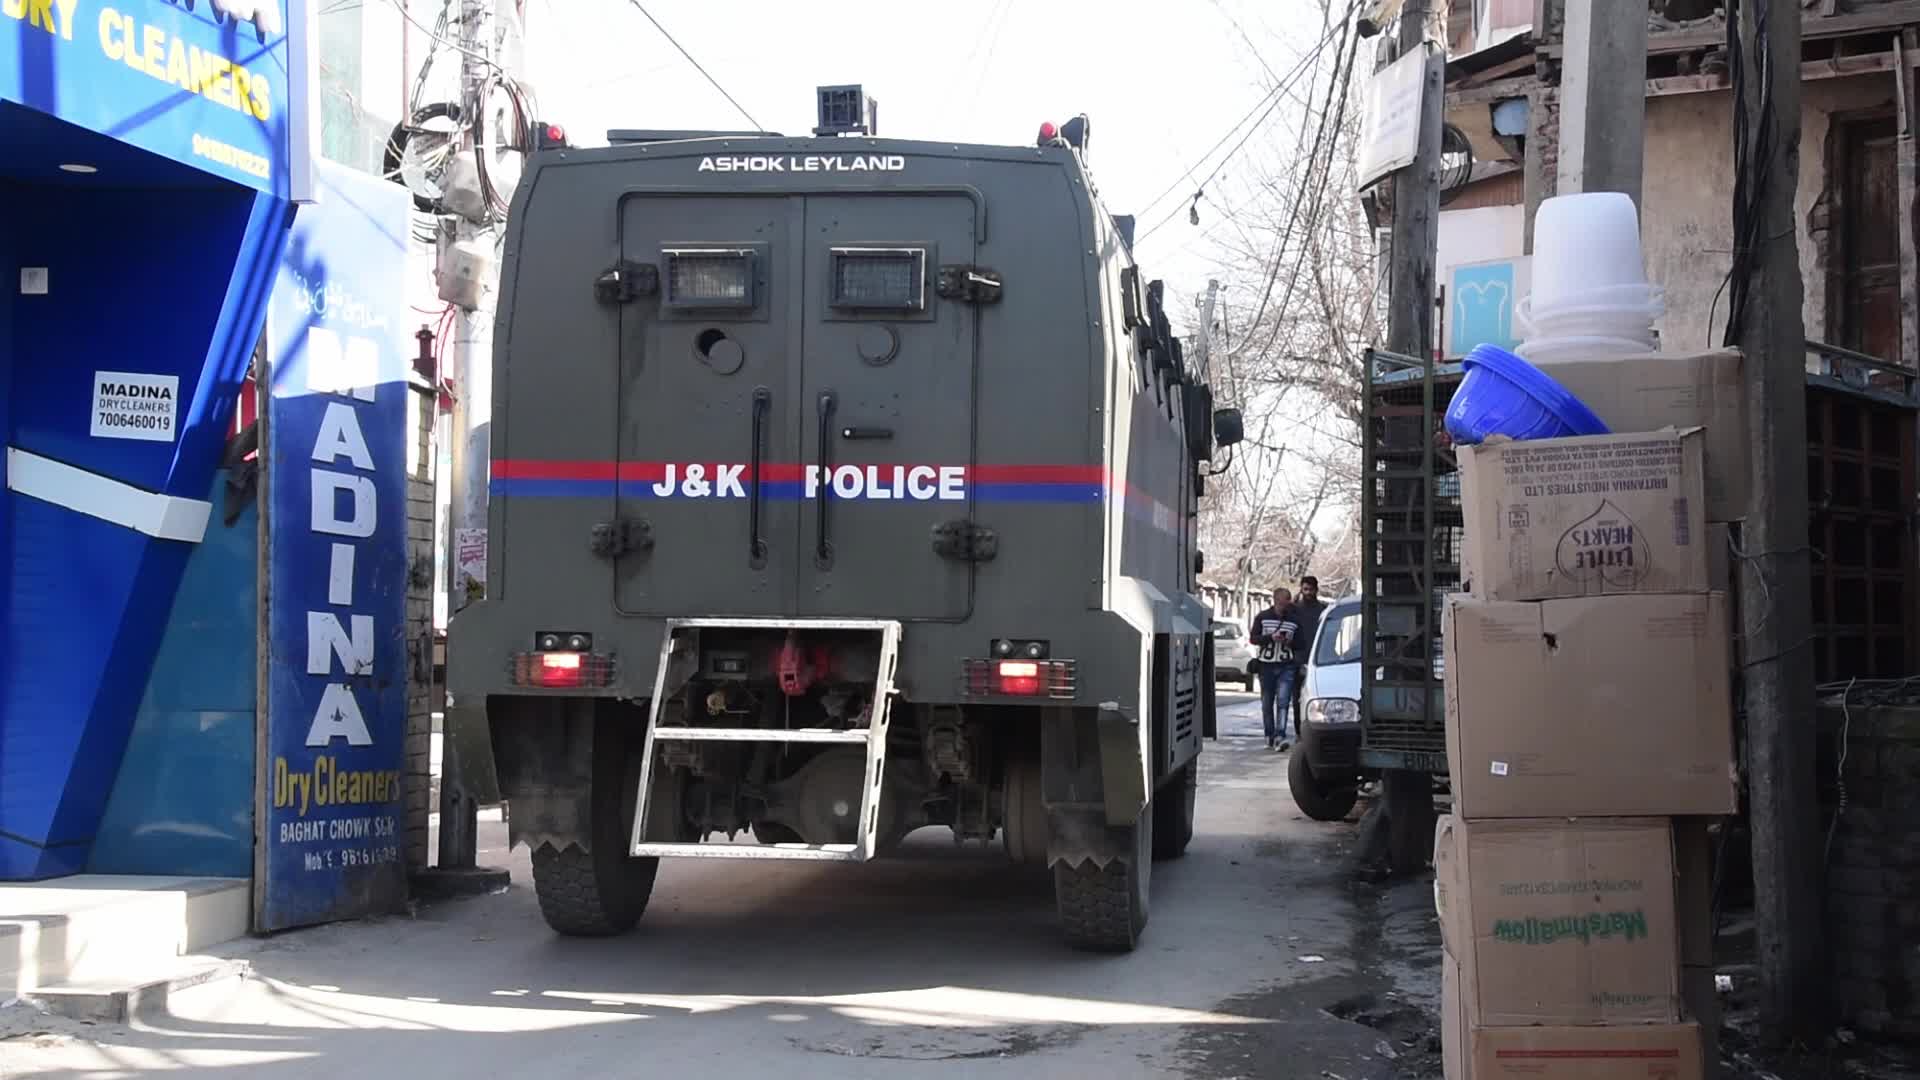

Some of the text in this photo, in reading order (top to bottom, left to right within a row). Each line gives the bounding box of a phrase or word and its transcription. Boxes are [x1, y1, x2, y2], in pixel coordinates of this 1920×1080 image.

[98, 7, 272, 122] CLEANERS
[698, 156, 905, 172] ASHOK LEYLAND
[100, 383, 172, 400] MADINA
[99, 412, 170, 430] 7006460019
[652, 464, 965, 499] J&K POLICE
[1524, 485, 1544, 497] LTD
[1571, 525, 1633, 546] HEARTS
[274, 756, 400, 816] Dry Cleaners
[280, 821, 326, 843] BAGHAT
[329, 818, 371, 839] CHOWK
